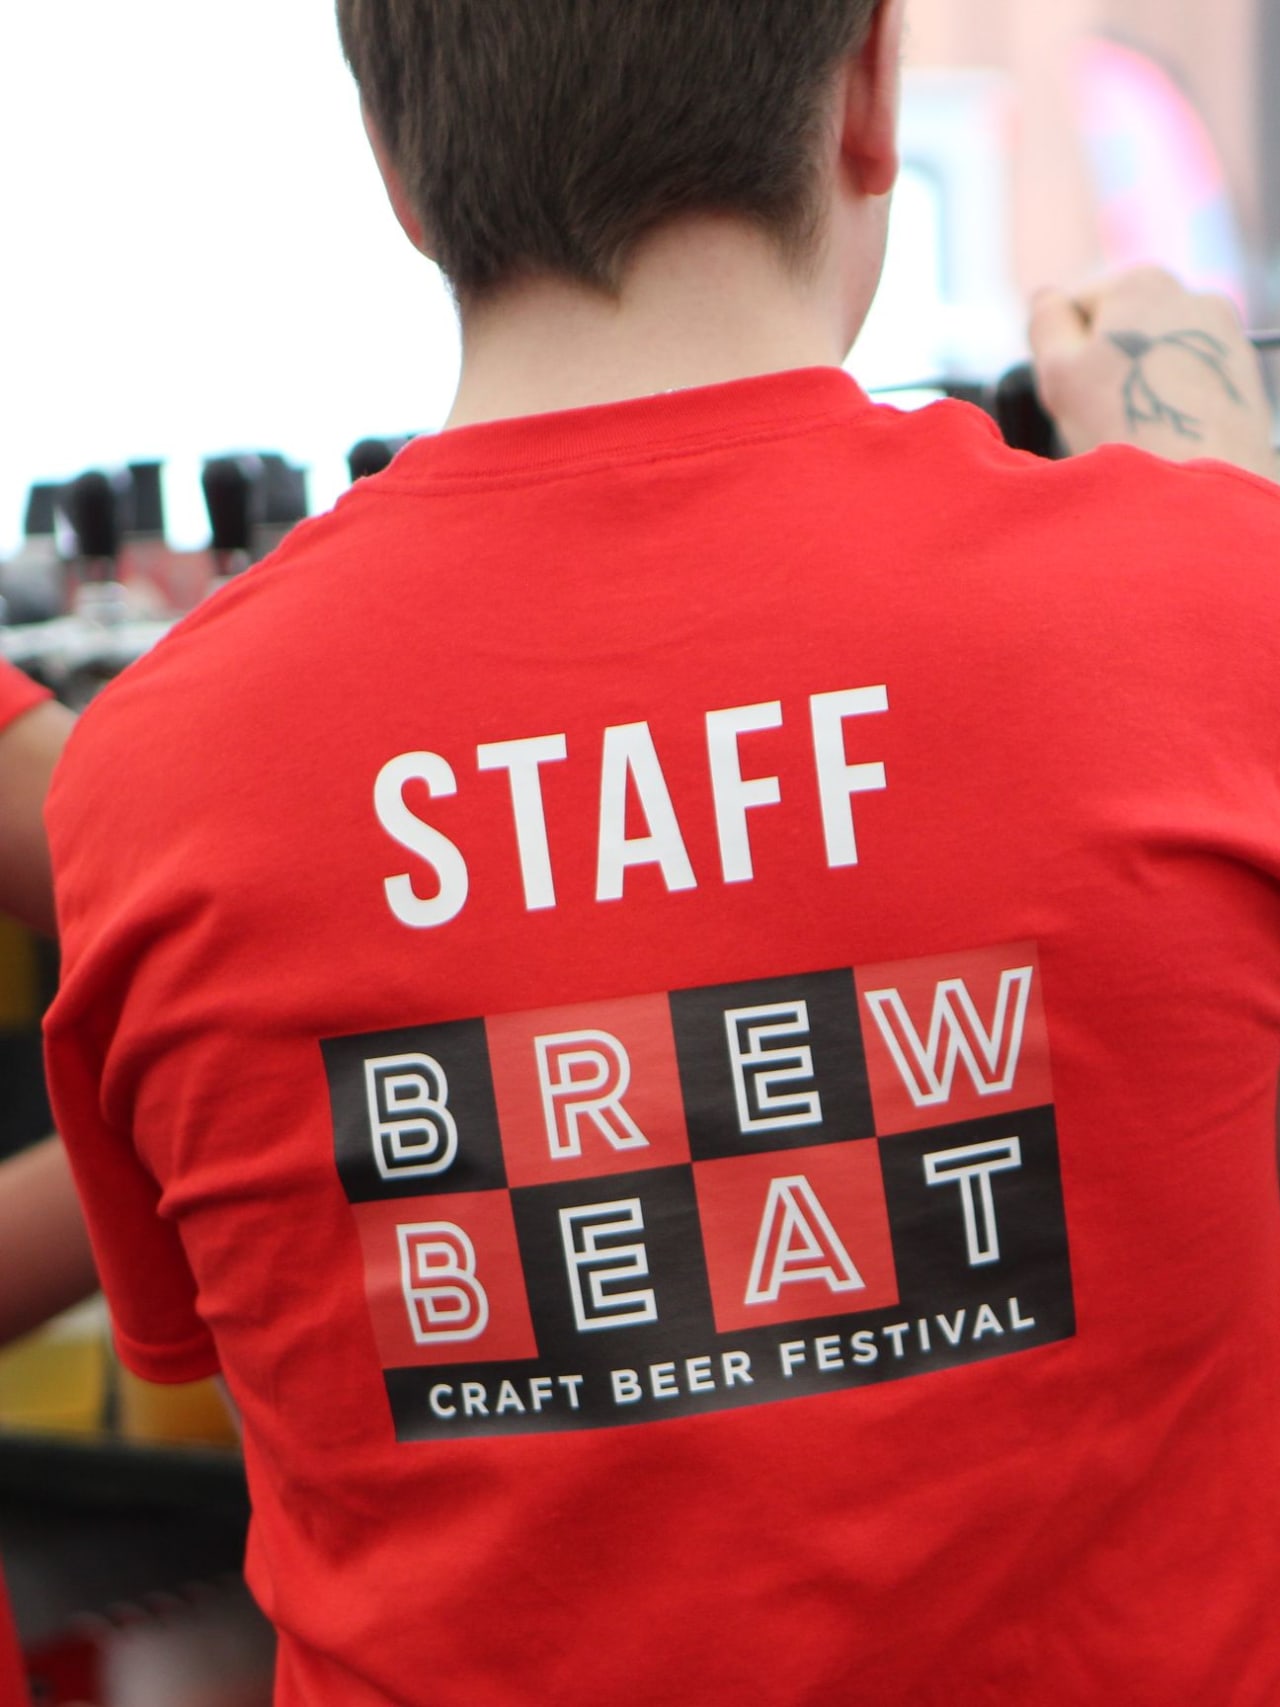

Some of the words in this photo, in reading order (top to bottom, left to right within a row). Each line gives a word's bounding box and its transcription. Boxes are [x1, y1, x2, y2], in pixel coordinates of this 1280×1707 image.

[373, 684, 889, 928] STAFF
[364, 965, 1034, 1180] BREW
[395, 1136, 1022, 1345] BEAT
[429, 1374, 584, 1418] CRAFT
[610, 1349, 754, 1405] BEER
[779, 1297, 1036, 1377] FESTIVAL
